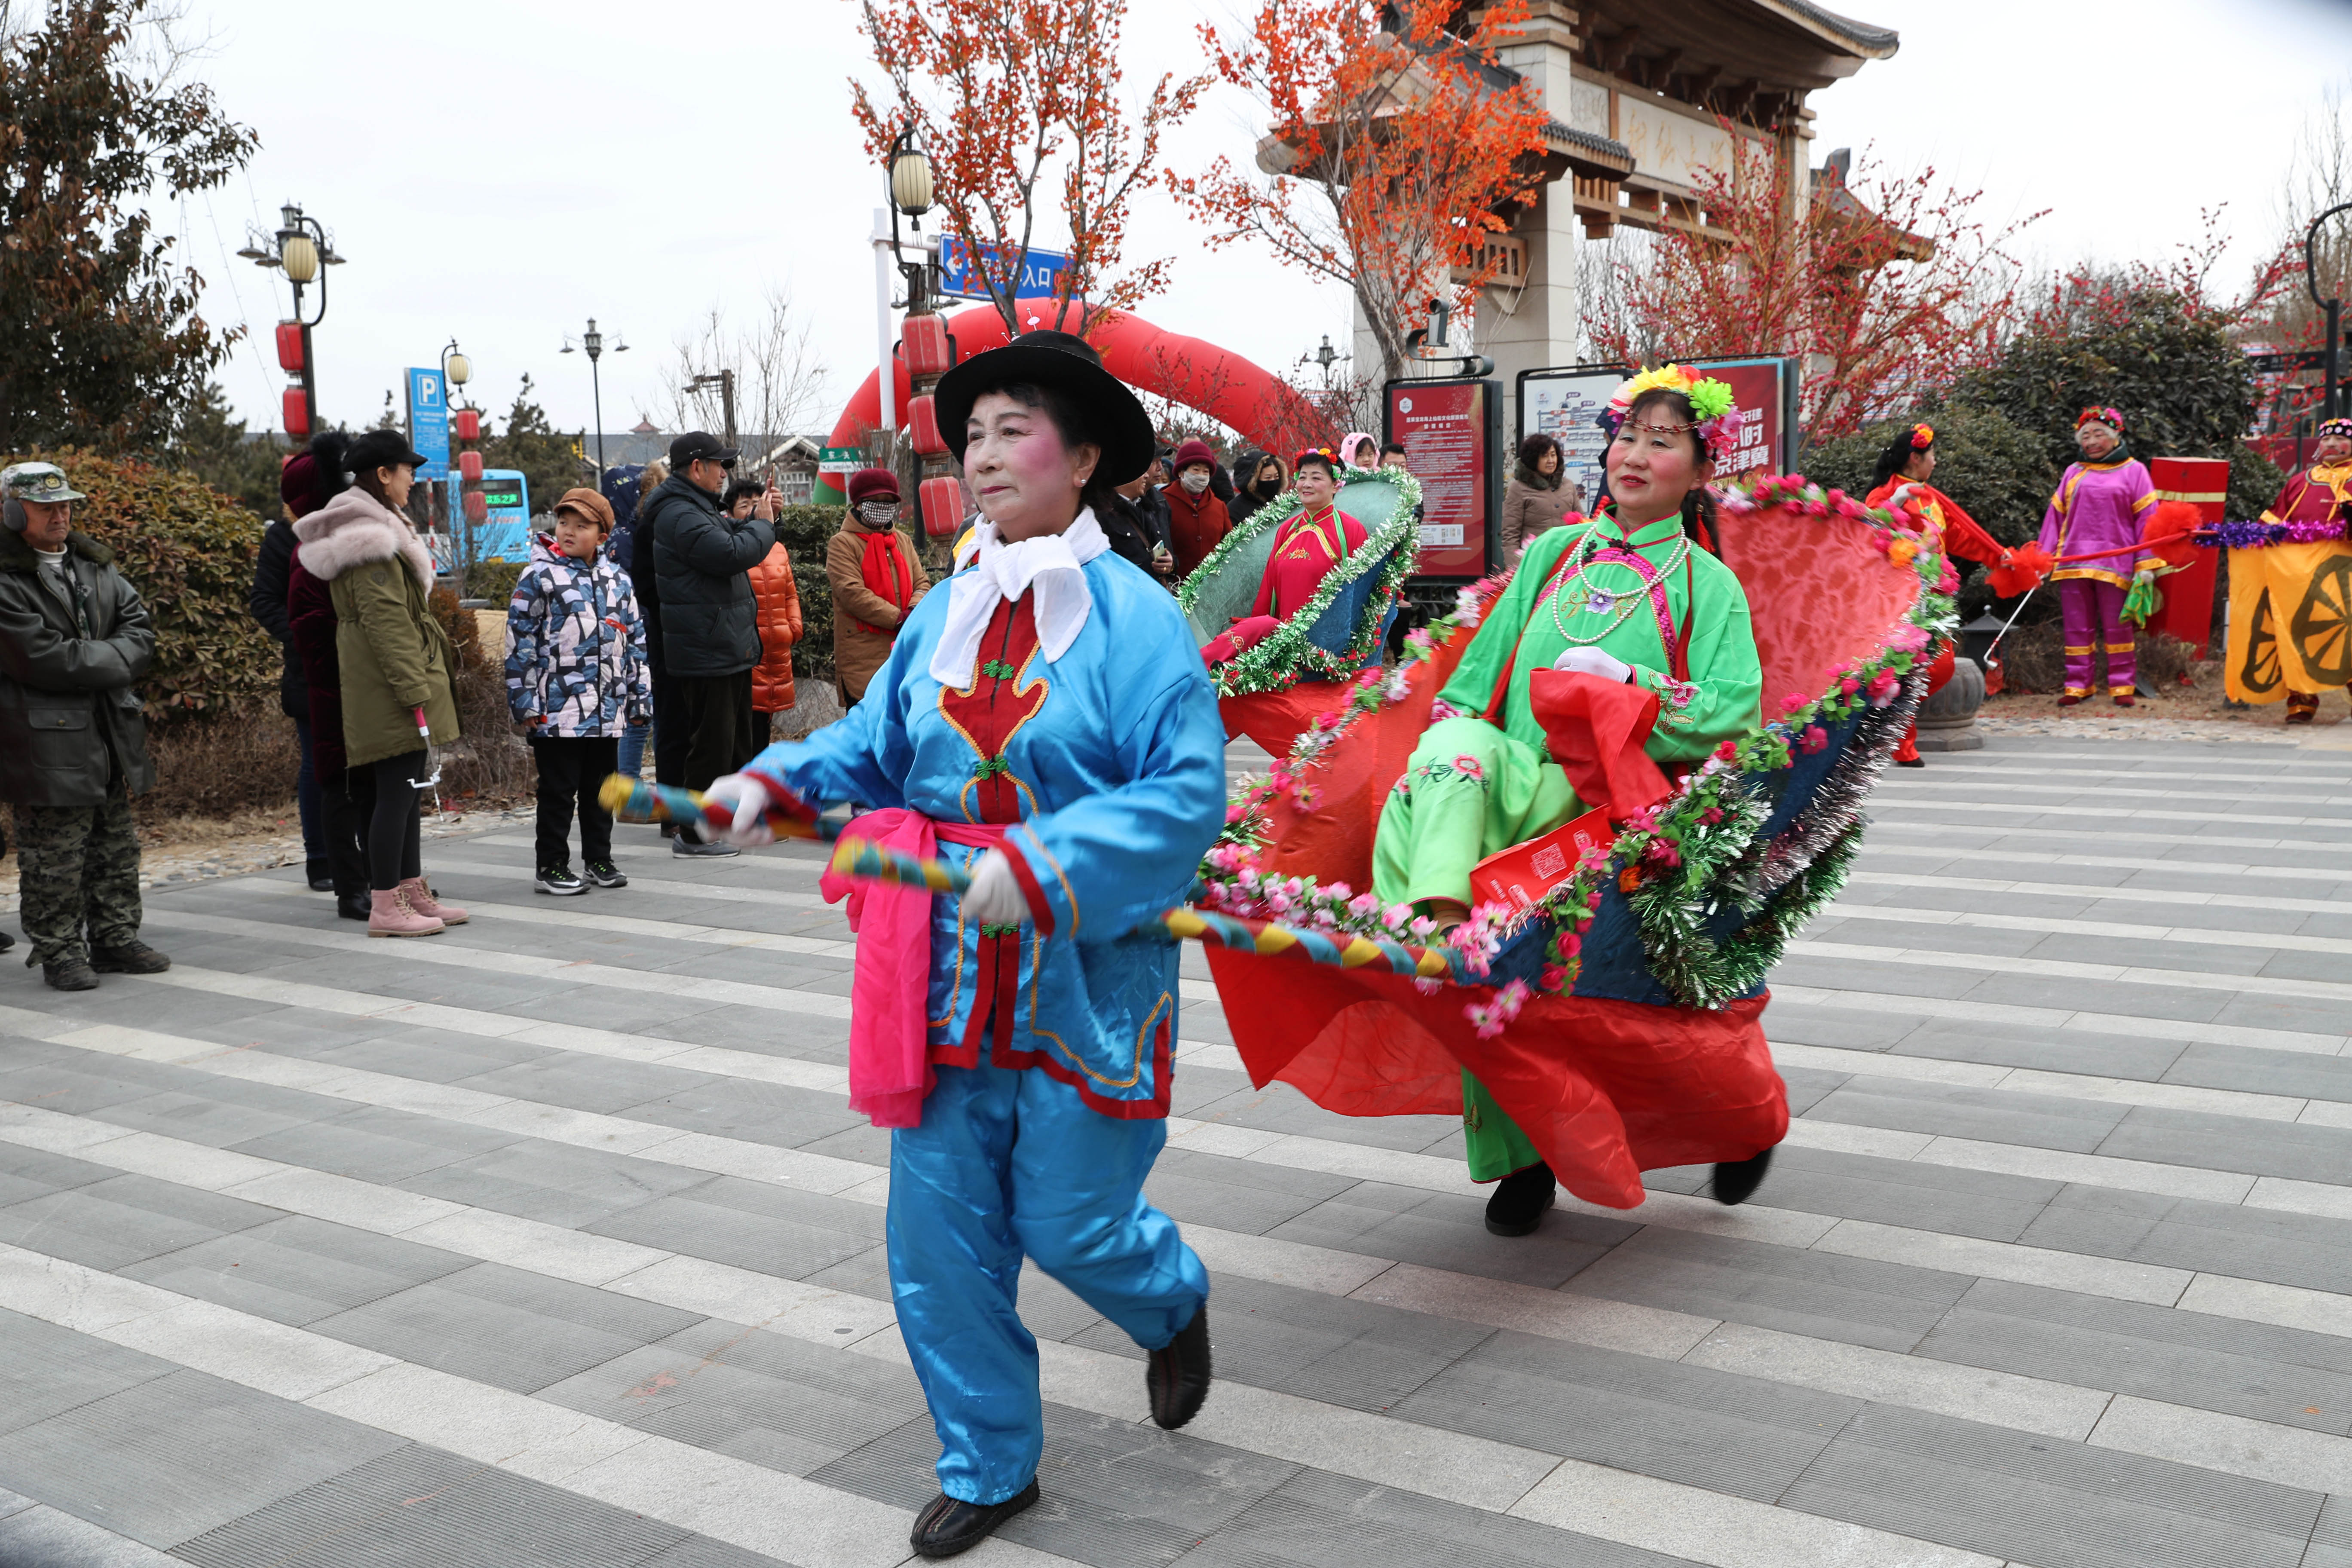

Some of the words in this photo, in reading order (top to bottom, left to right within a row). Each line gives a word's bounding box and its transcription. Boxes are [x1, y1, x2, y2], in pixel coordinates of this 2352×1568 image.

[422, 378, 436, 403] P
[1715, 444, 1769, 477] 京津冀
